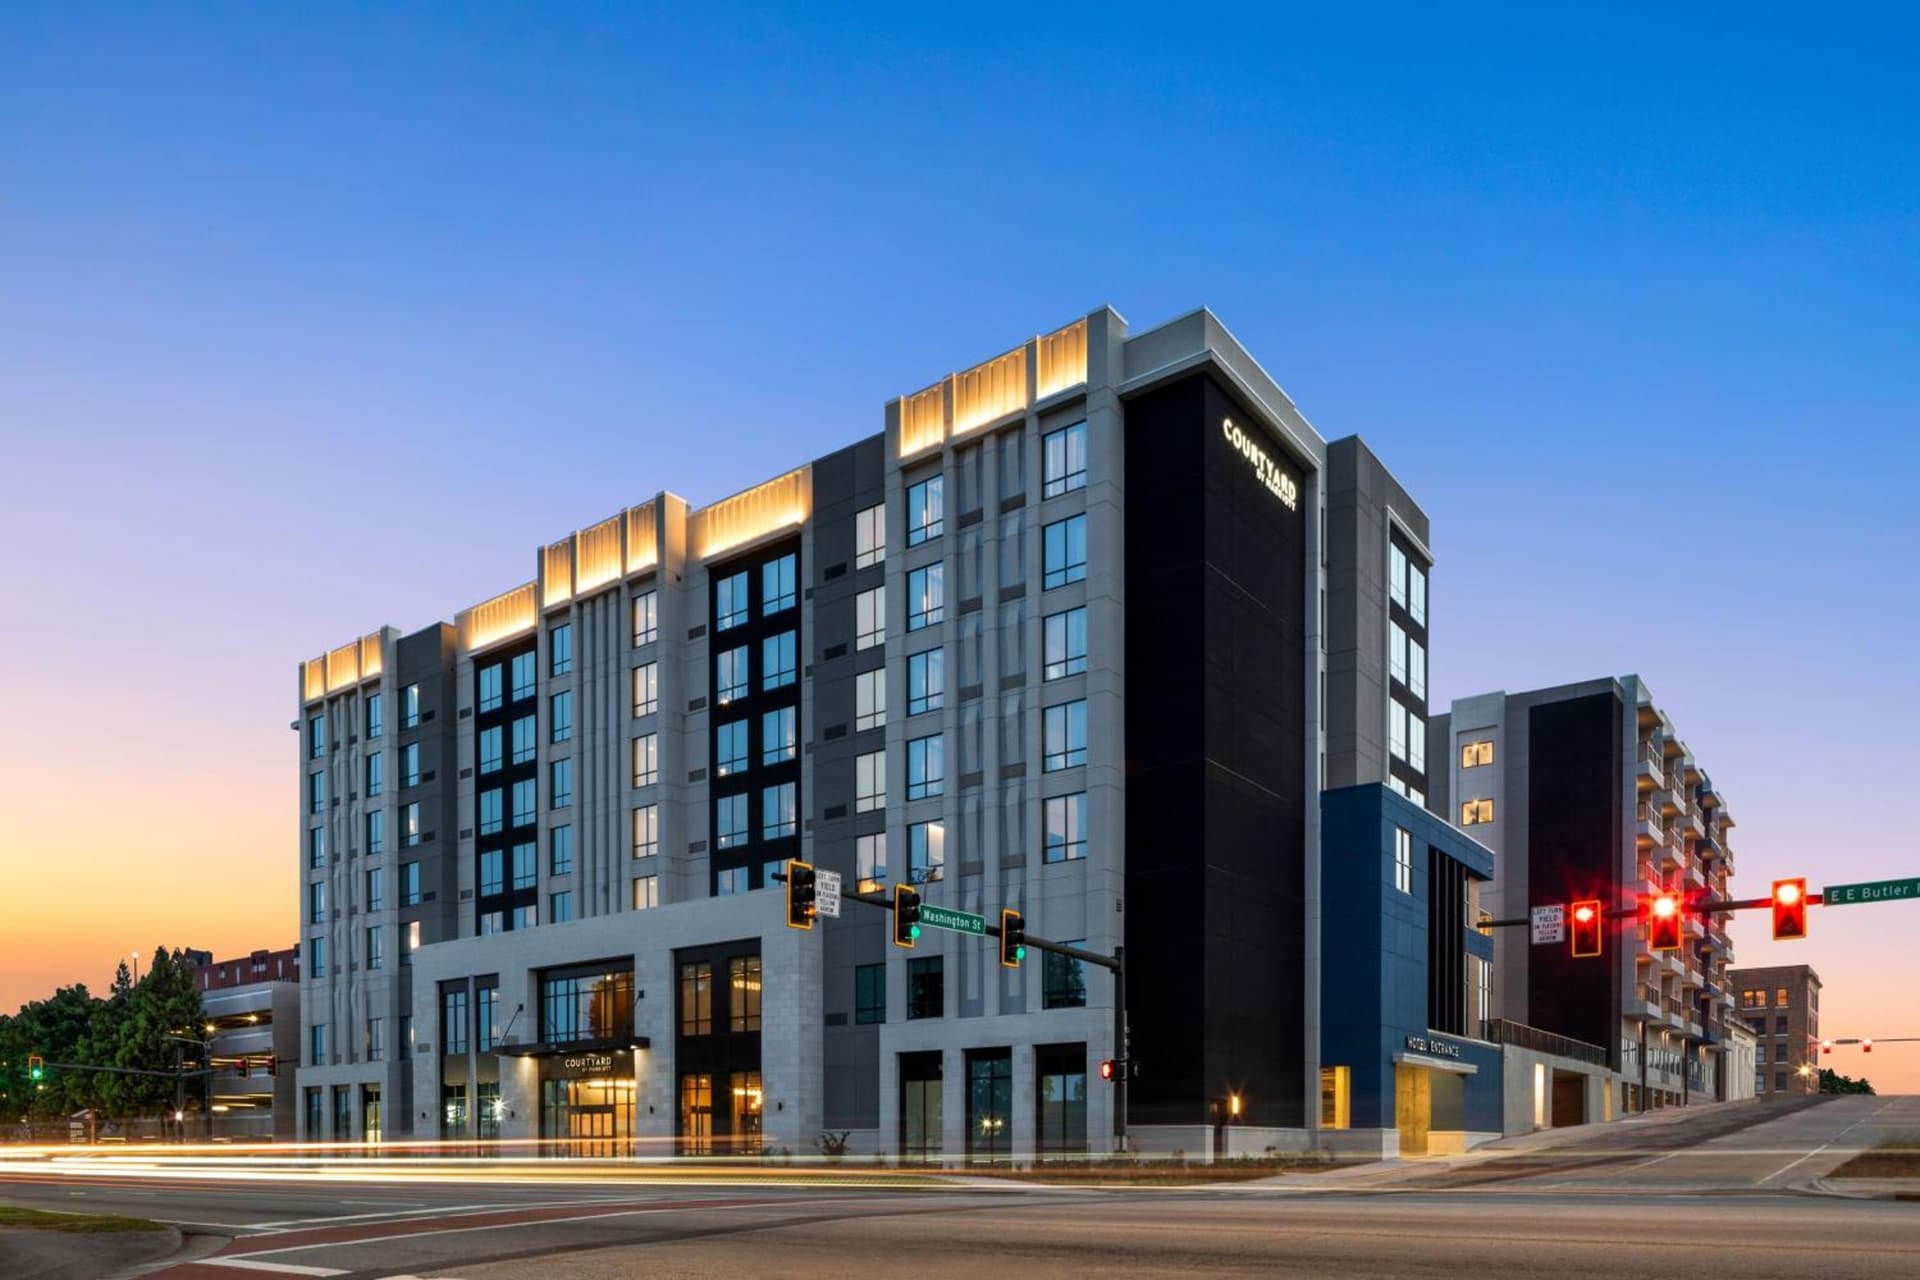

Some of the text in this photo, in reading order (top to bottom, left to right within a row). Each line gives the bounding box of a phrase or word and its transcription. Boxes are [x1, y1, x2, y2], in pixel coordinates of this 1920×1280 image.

[1223, 418, 1296, 501] COURTYARD
[1831, 890, 1840, 901] E
[1846, 888, 1856, 900] E
[1861, 885, 1909, 899] Butler
[923, 909, 981, 930] Washington St
[1408, 1035, 1459, 1057] HOTEL ENTRANCE
[565, 1056, 612, 1068] COURTYARD
